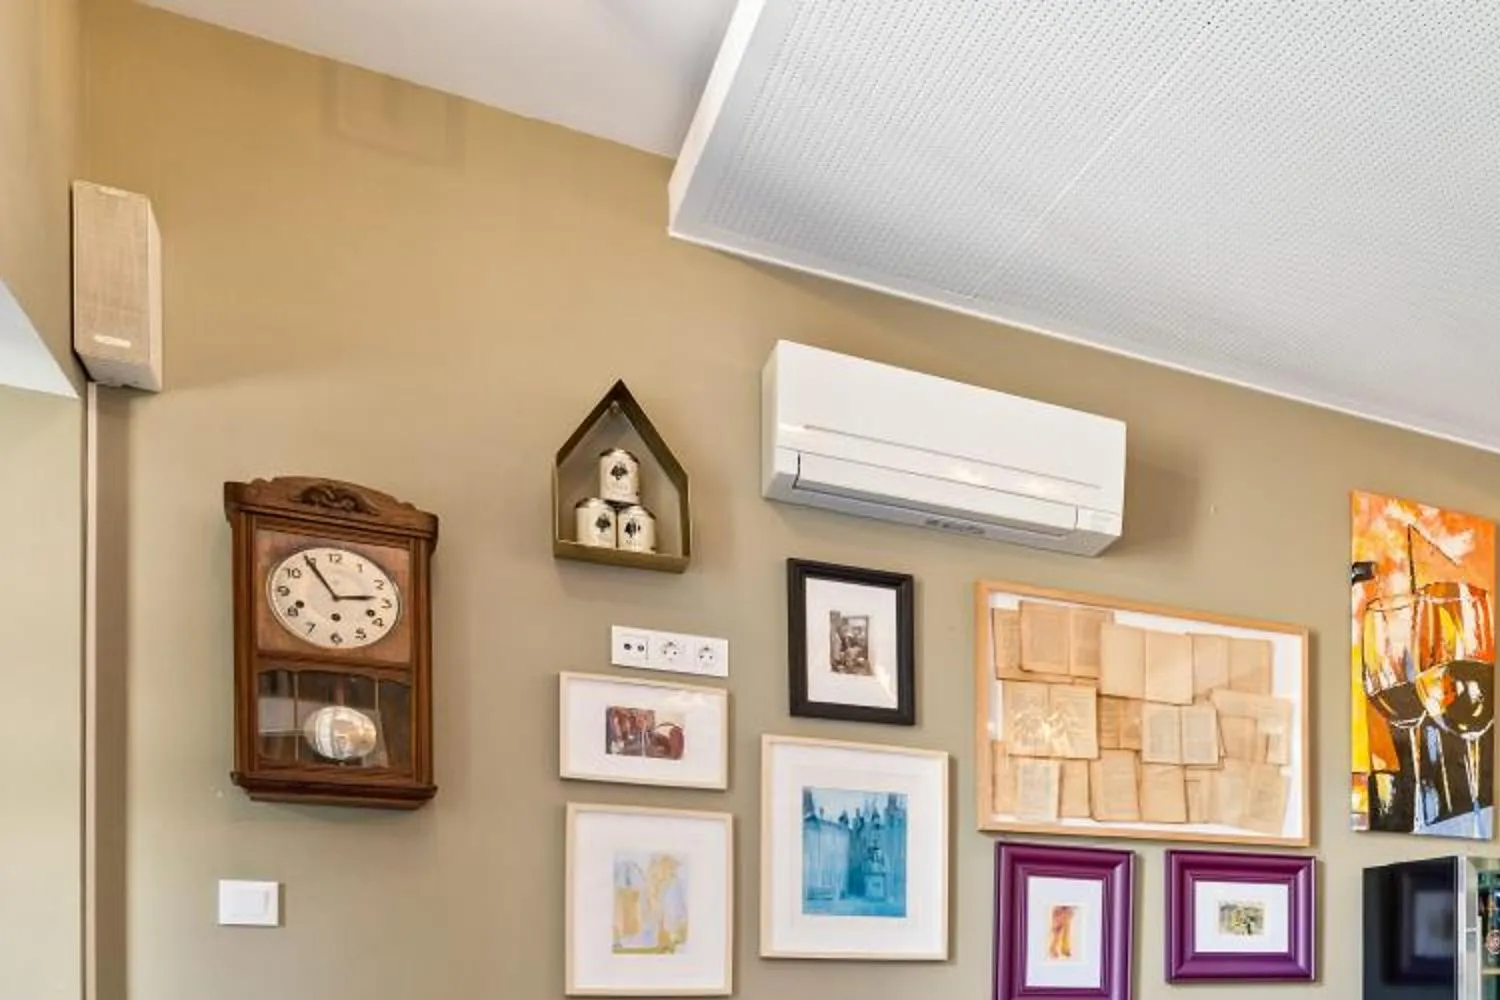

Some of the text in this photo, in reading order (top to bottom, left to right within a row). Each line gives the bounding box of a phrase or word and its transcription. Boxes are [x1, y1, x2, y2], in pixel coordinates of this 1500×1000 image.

[328, 553, 342, 564] 12
[285, 568, 302, 579] 10
[357, 564, 363, 573] 1
[374, 580, 385, 590] 2
[277, 585, 291, 597] 9
[381, 599, 393, 609] 3
[305, 621, 316, 635] 7
[372, 617, 384, 628] 4
[330, 632, 343, 645] 6
[355, 627, 367, 640] 5
